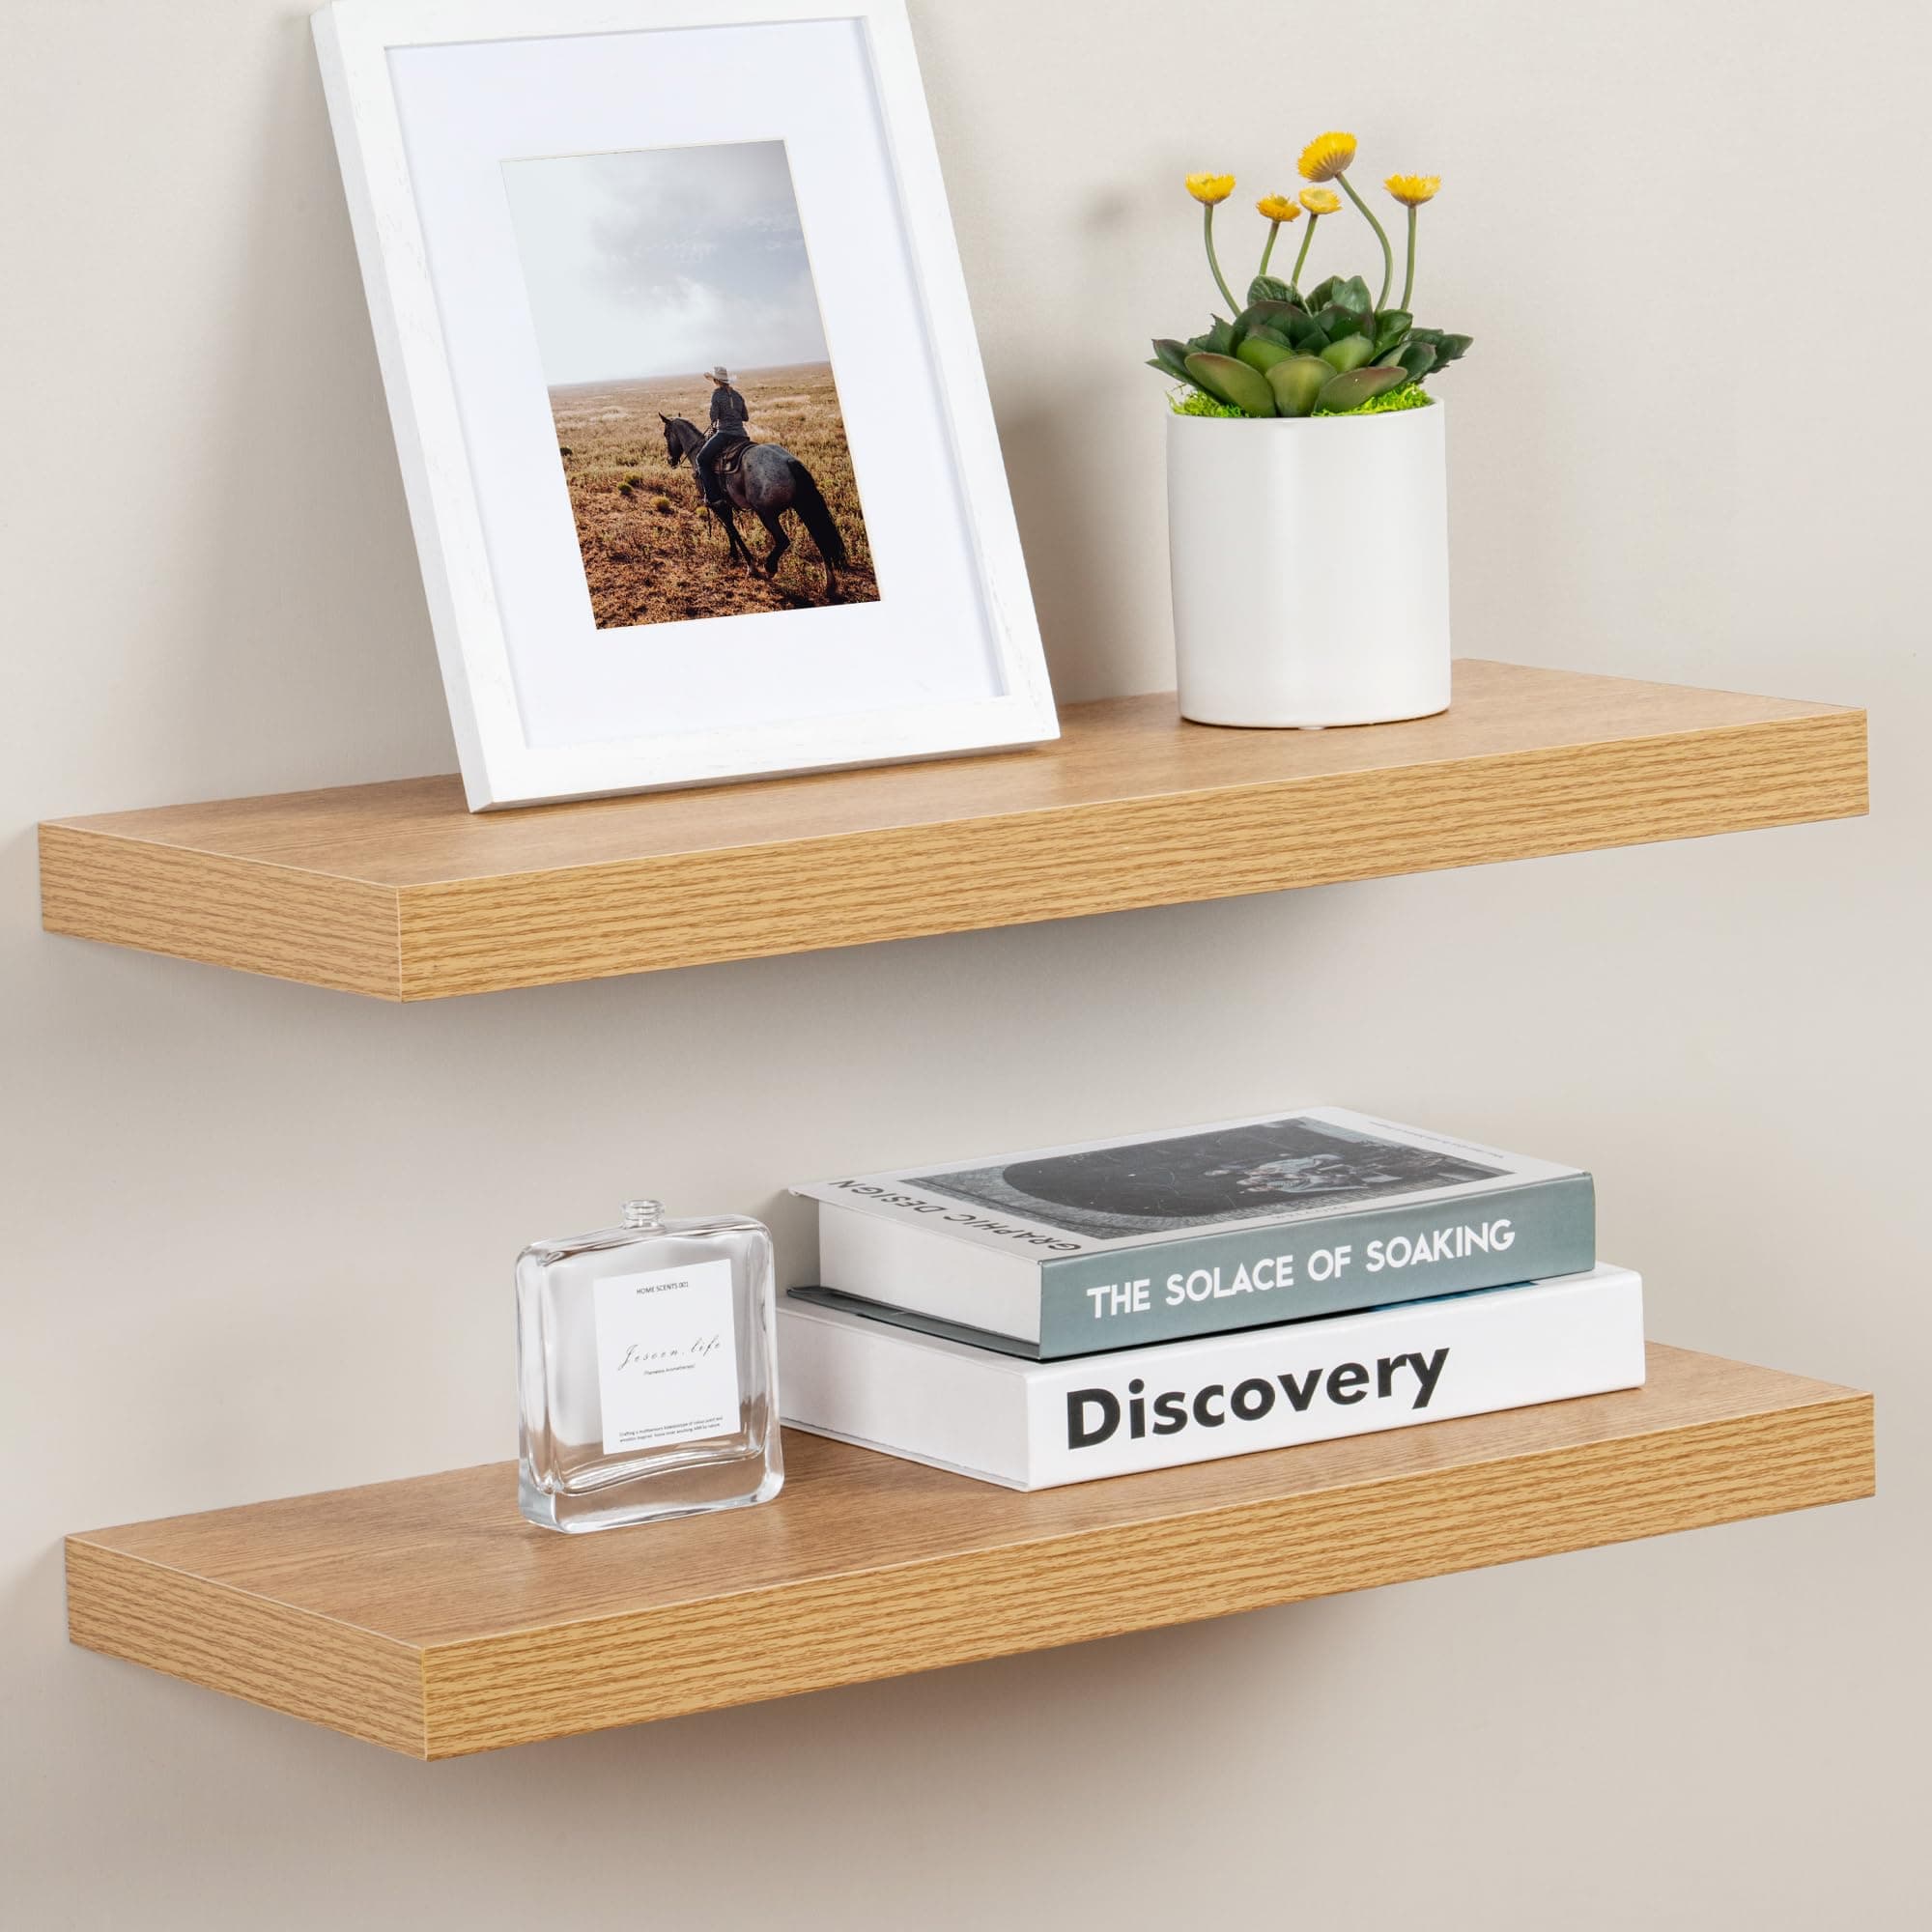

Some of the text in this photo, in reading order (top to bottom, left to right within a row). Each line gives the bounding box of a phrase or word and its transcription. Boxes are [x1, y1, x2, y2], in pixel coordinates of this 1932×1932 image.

[829, 1179, 1082, 1251] GRAPHIC DESIGN
[637, 1286, 655, 1294] HOME
[656, 1282, 678, 1292] SCENTS
[1086, 1218, 1516, 1319] THE SOLACE OF SOAKING
[1066, 1348, 1450, 1450] Discovery
